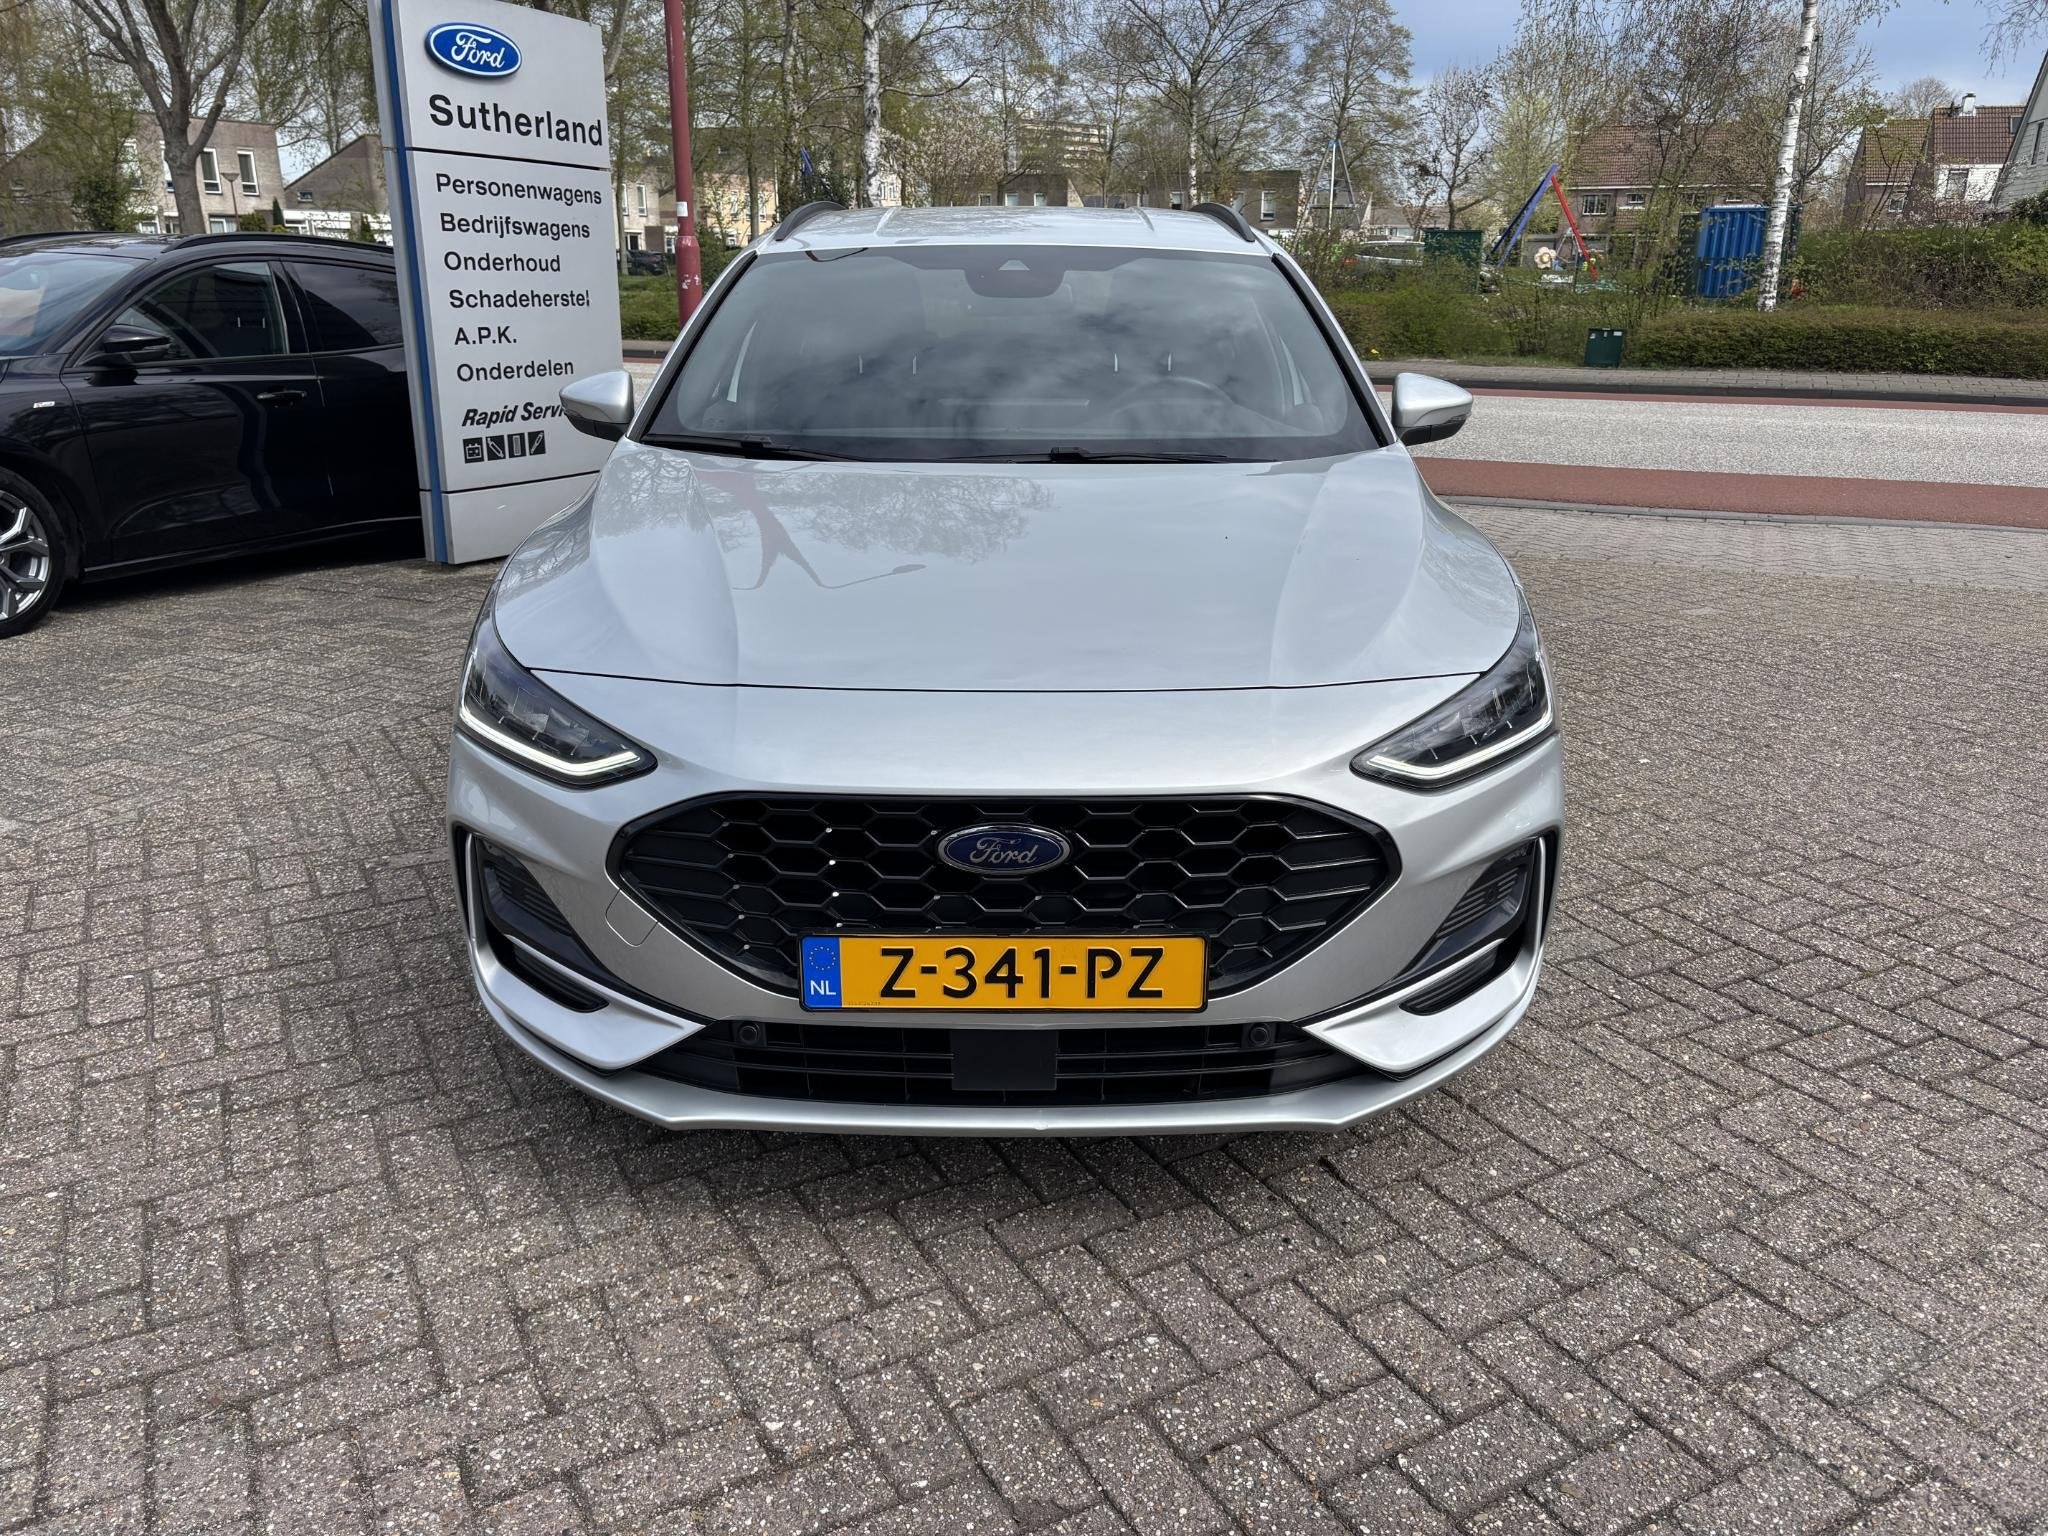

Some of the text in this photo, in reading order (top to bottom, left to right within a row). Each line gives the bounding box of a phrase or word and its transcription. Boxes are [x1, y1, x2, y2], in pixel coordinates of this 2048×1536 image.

[451, 31, 506, 68] Ford
[429, 94, 602, 146] Sutherland
[436, 173, 602, 206] Personenwagens
[440, 213, 590, 241] Bedrijfswagens
[444, 251, 561, 272] Onderhoud
[449, 289, 590, 309] Schadeherstel
[454, 326, 517, 345] A.P.K.
[457, 359, 574, 382] Onderdelen
[461, 405, 518, 429] Rapid
[969, 837, 1039, 864] Ford
[880, 947, 1165, 999] Z-341-PZ
[810, 979, 837, 996] NL
